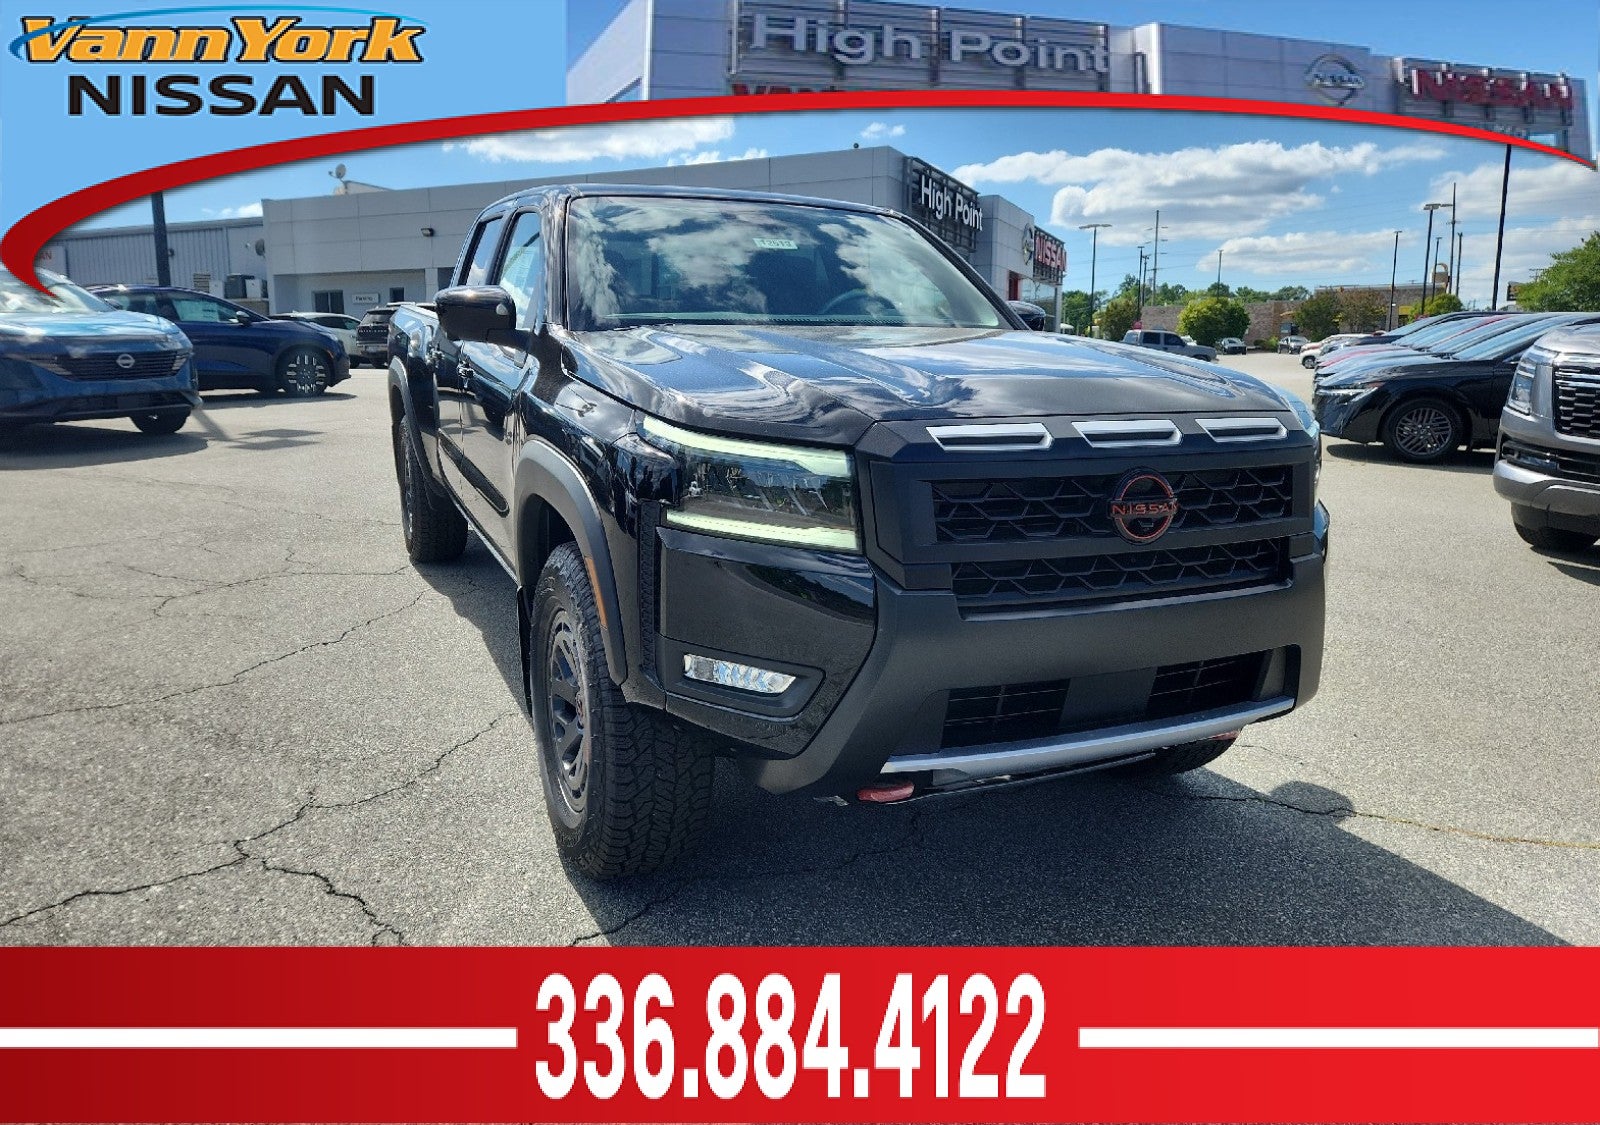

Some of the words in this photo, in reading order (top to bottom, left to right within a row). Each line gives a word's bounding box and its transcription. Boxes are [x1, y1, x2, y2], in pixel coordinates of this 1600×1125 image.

[749, 13, 922, 65] High
[950, 29, 1110, 73] Point
[920, 174, 951, 220] High
[955, 193, 983, 231] Point
[1034, 234, 1067, 273] NISSAN
[1111, 501, 1178, 515] NISSAN
